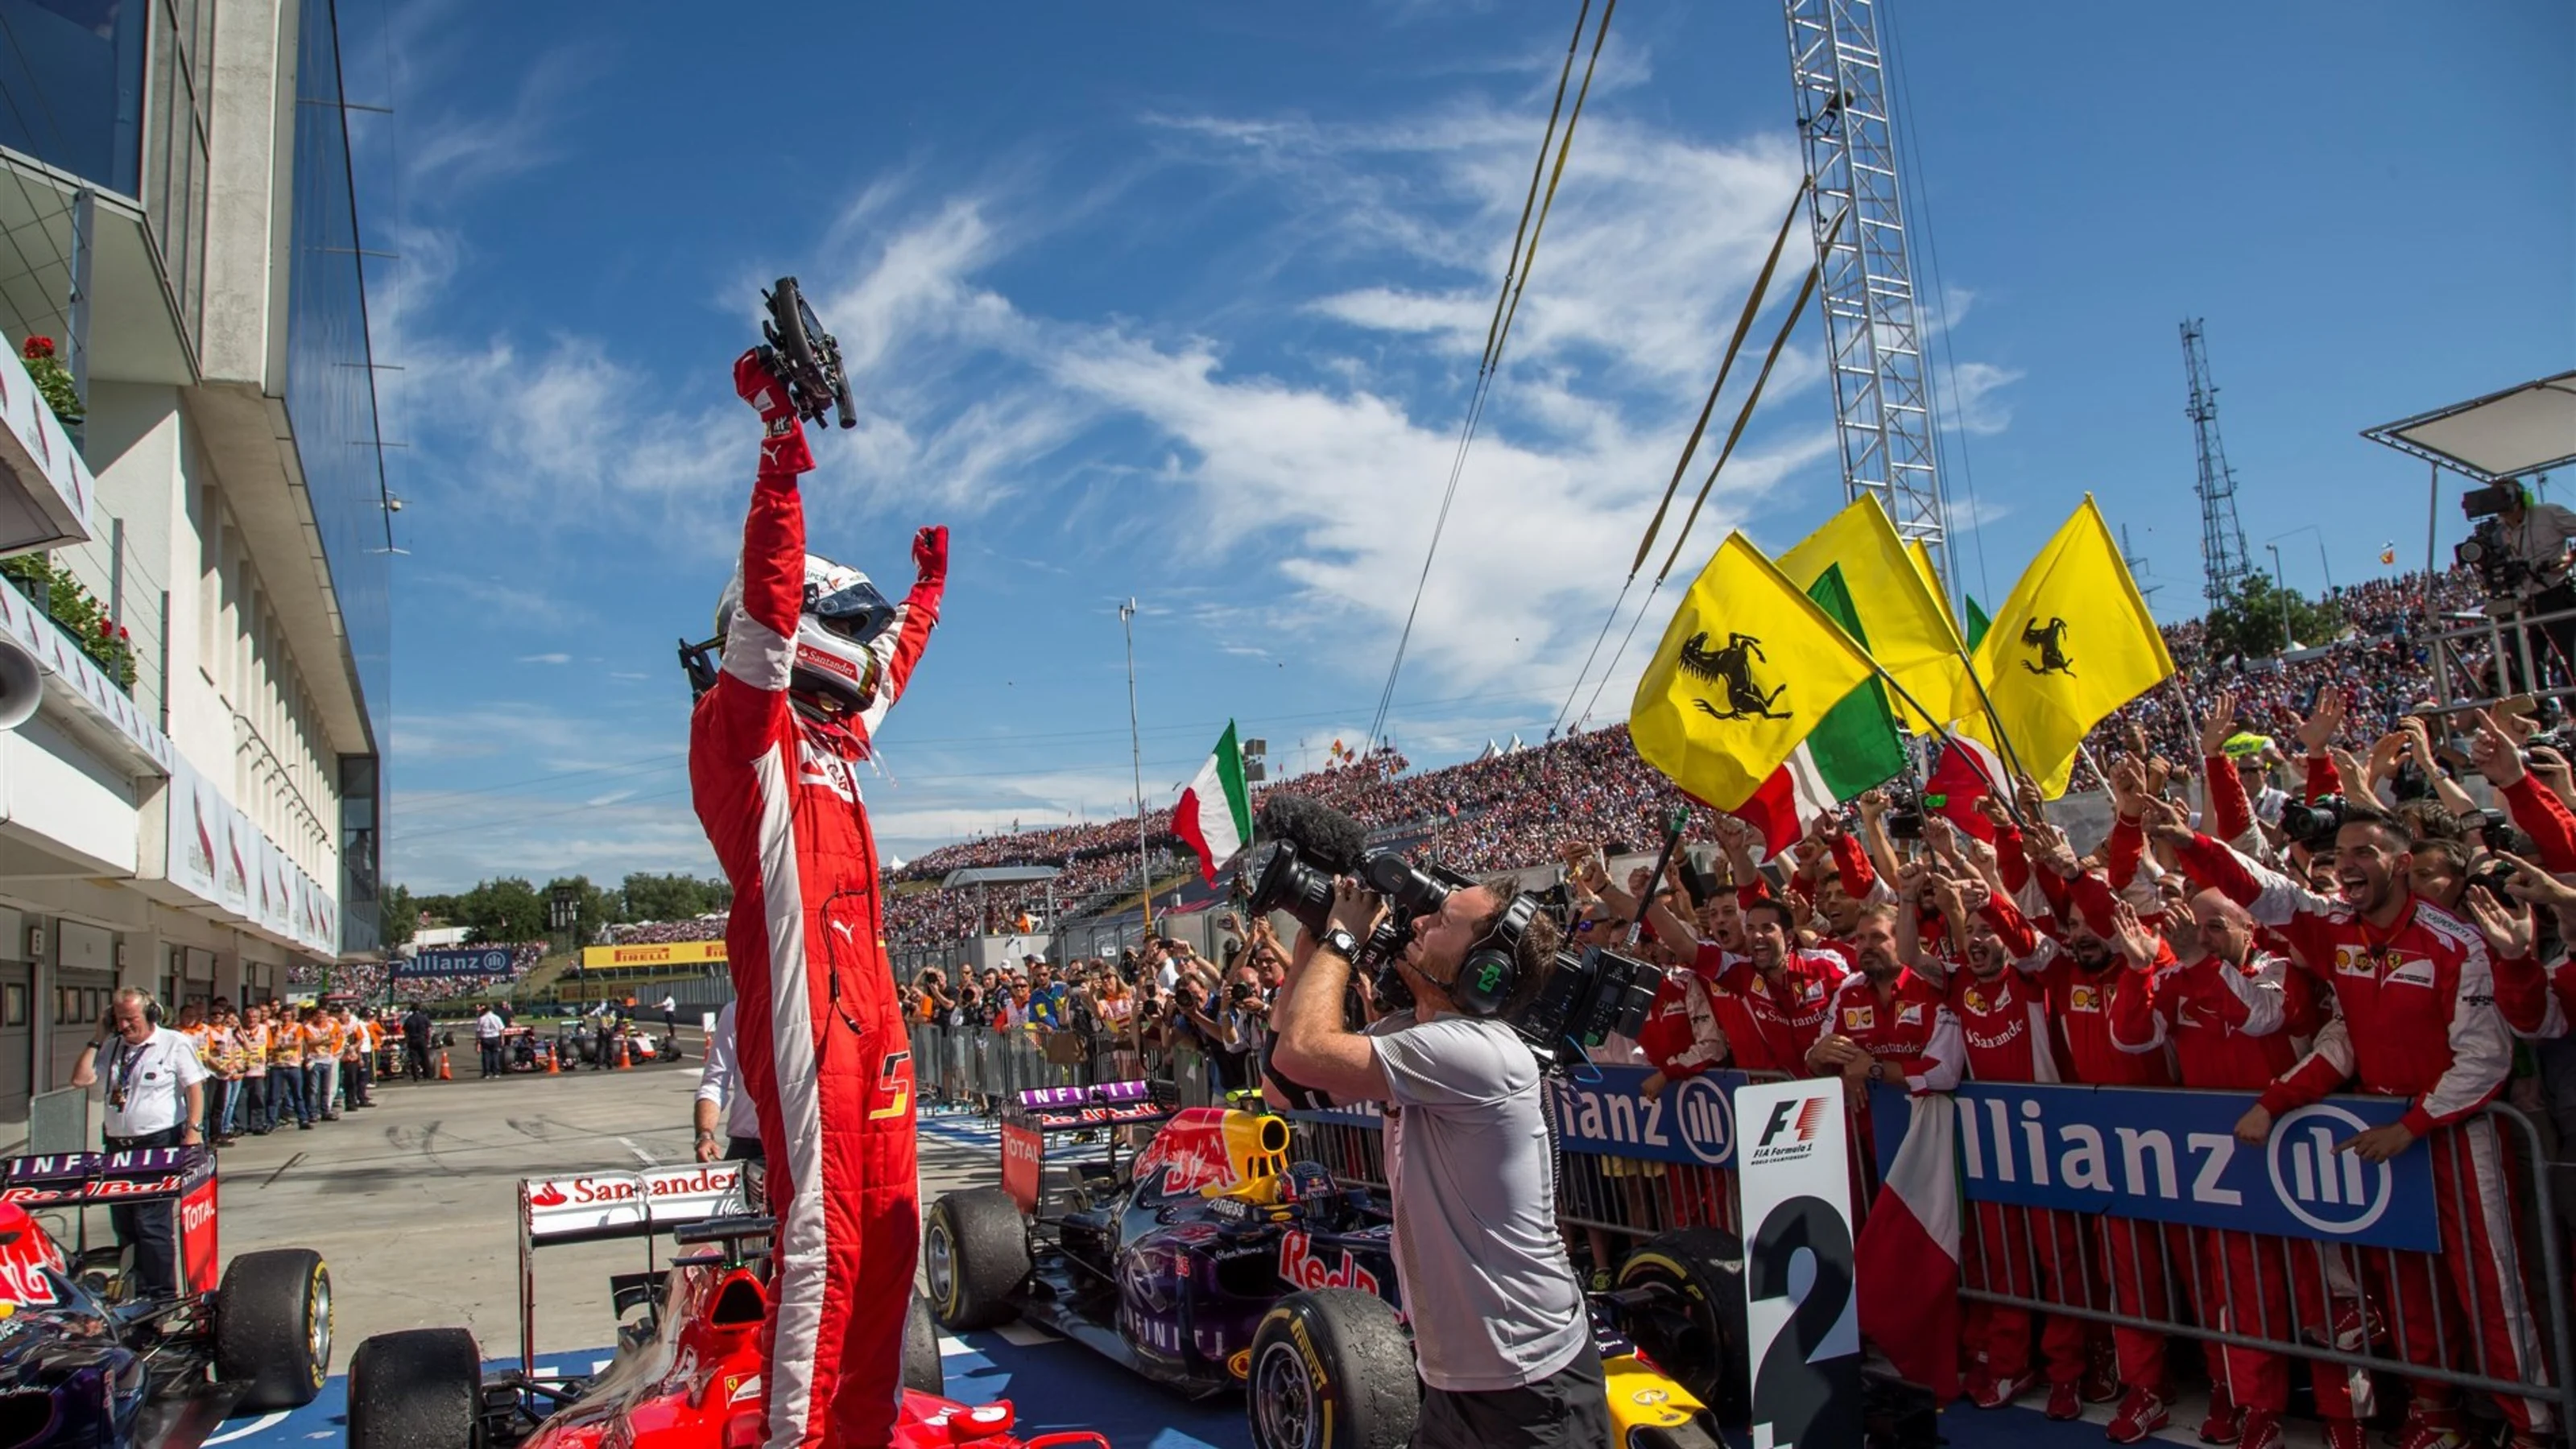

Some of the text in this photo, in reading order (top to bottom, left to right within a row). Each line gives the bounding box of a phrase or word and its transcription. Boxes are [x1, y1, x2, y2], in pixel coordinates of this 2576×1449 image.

[808, 650, 854, 675] Santander
[399, 955, 479, 972] Allianz
[614, 947, 670, 963] PIRELLI
[1482, 971, 1495, 988] 2
[1768, 1008, 1829, 1028] Santande
[1866, 1041, 1921, 1055] Santande
[869, 1050, 911, 1120] 5
[1758, 1096, 1832, 1147] F1
[1003, 1130, 1040, 1164] TOTAL
[1753, 1142, 1813, 1158] FIA Formula 1
[1905, 1096, 2243, 1206] llianz
[574, 1168, 740, 1203] Sanander
[182, 1196, 215, 1233] TOTAL
[1278, 1229, 1353, 1292] Red
[1749, 1195, 1865, 1449] 2
